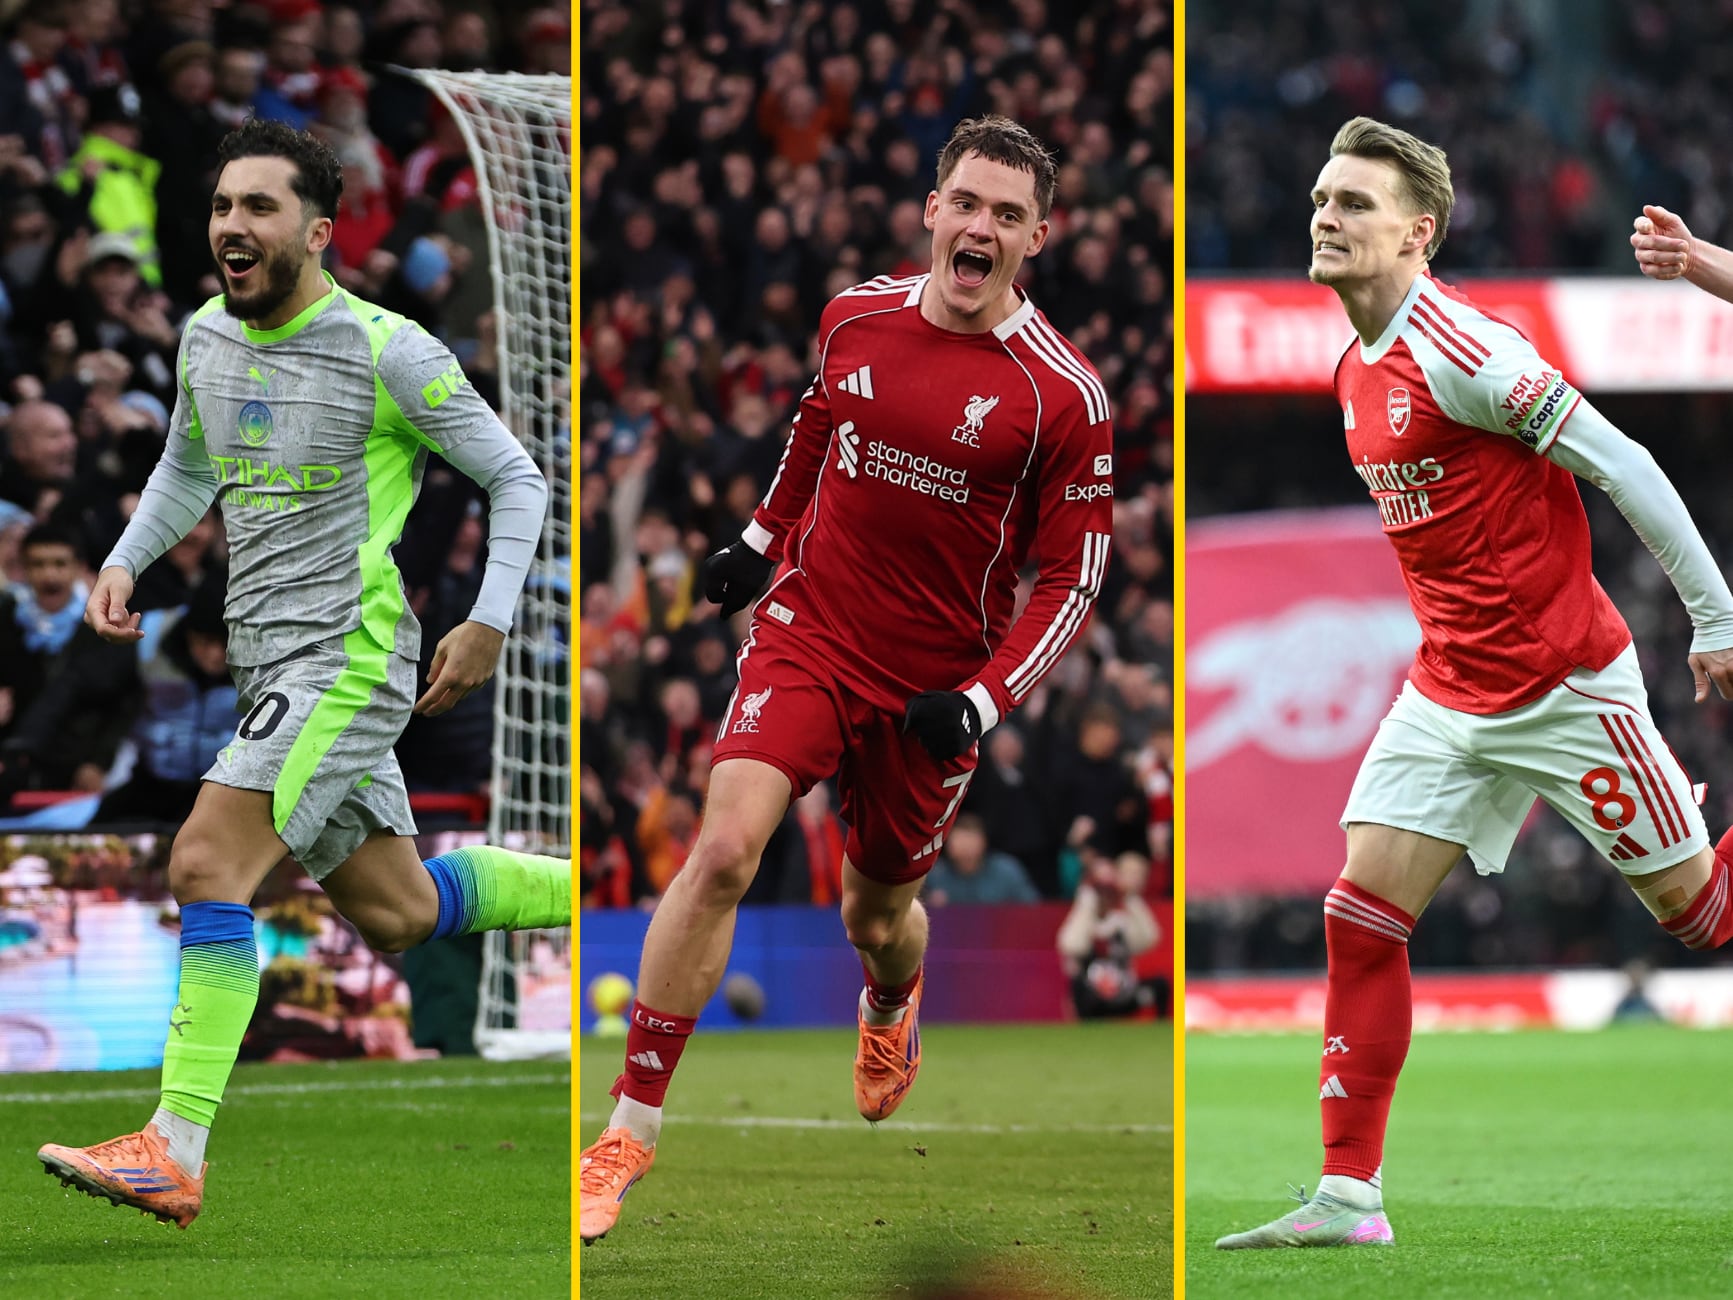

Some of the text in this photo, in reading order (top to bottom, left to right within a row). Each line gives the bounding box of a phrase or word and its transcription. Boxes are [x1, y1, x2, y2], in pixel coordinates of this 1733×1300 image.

[1501, 374, 1532, 411] VISIT
[1505, 370, 1555, 429] RWANDA
[1529, 382, 1568, 430] Captain
[864, 459, 970, 504] chartered
[866, 440, 968, 486] standard
[1378, 489, 1434, 526] BETTER
[933, 767, 976, 829] 7
[1579, 765, 1637, 832] 8
[635, 1009, 676, 1034] LFC
